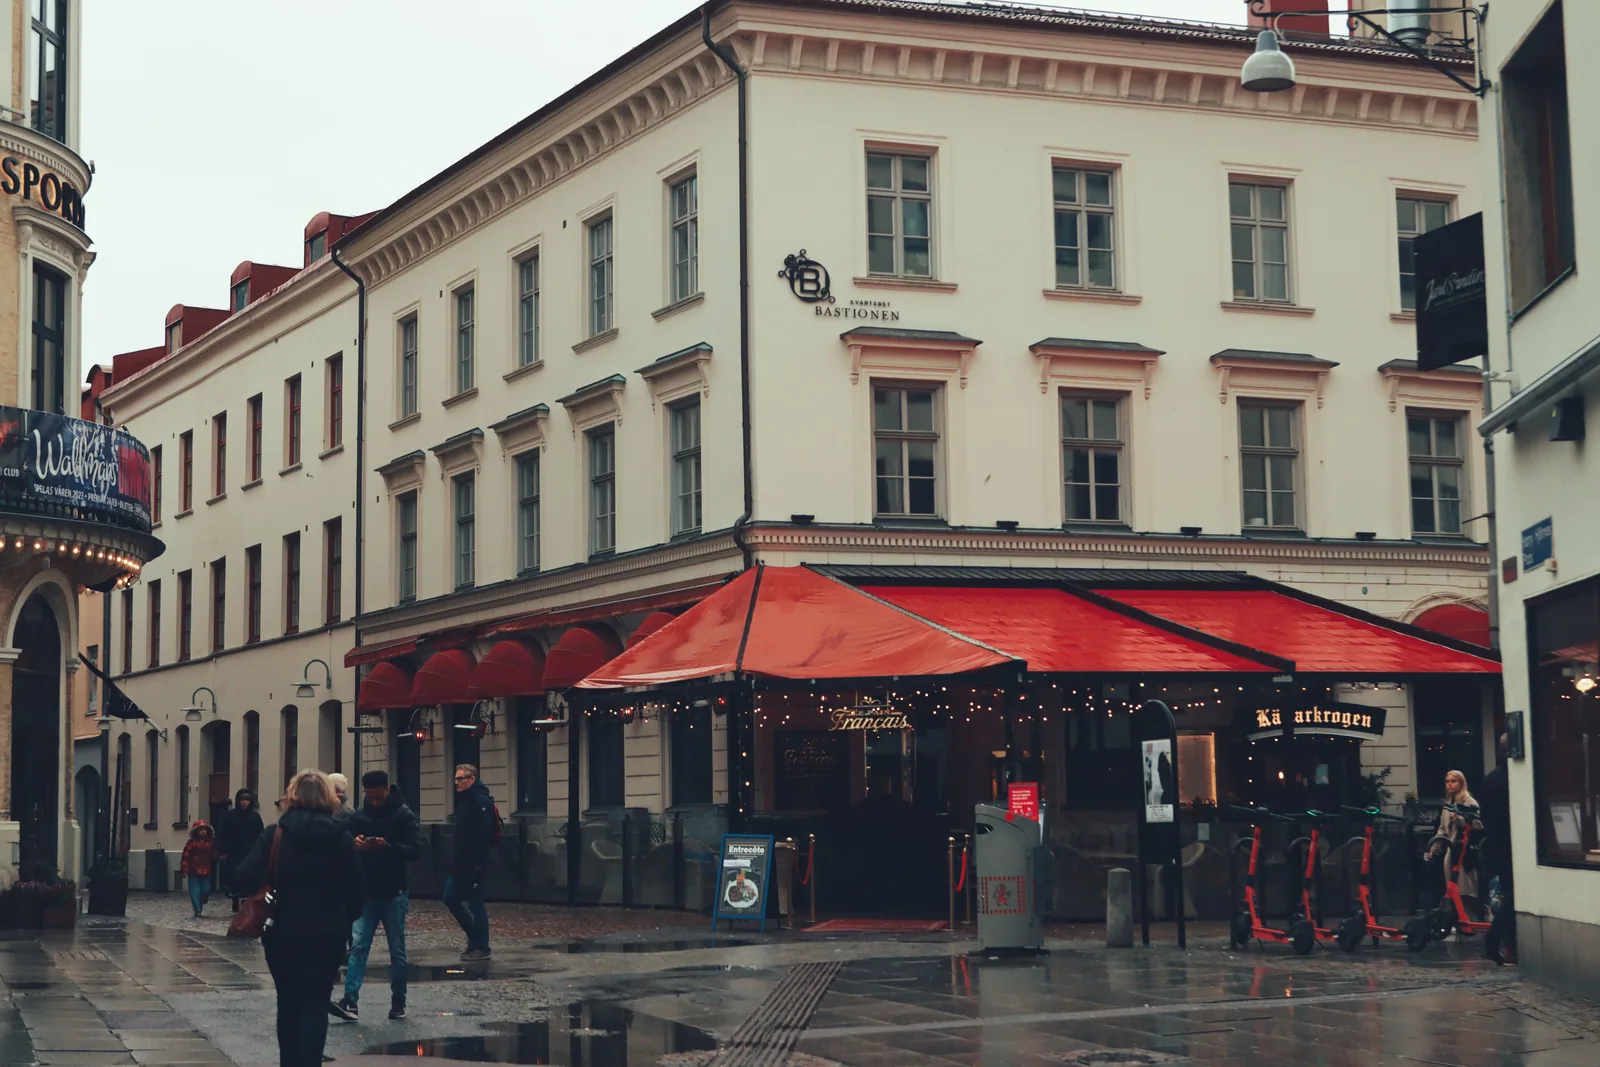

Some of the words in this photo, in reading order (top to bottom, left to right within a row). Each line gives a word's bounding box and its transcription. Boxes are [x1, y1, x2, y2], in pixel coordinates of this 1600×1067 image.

[849, 299, 891, 308] KVARTERET
[814, 305, 900, 322] BASTIONEN
[3, 467, 20, 477] CLUB
[828, 708, 908, 732] Français
[1256, 705, 1372, 728] Käarkrogen
